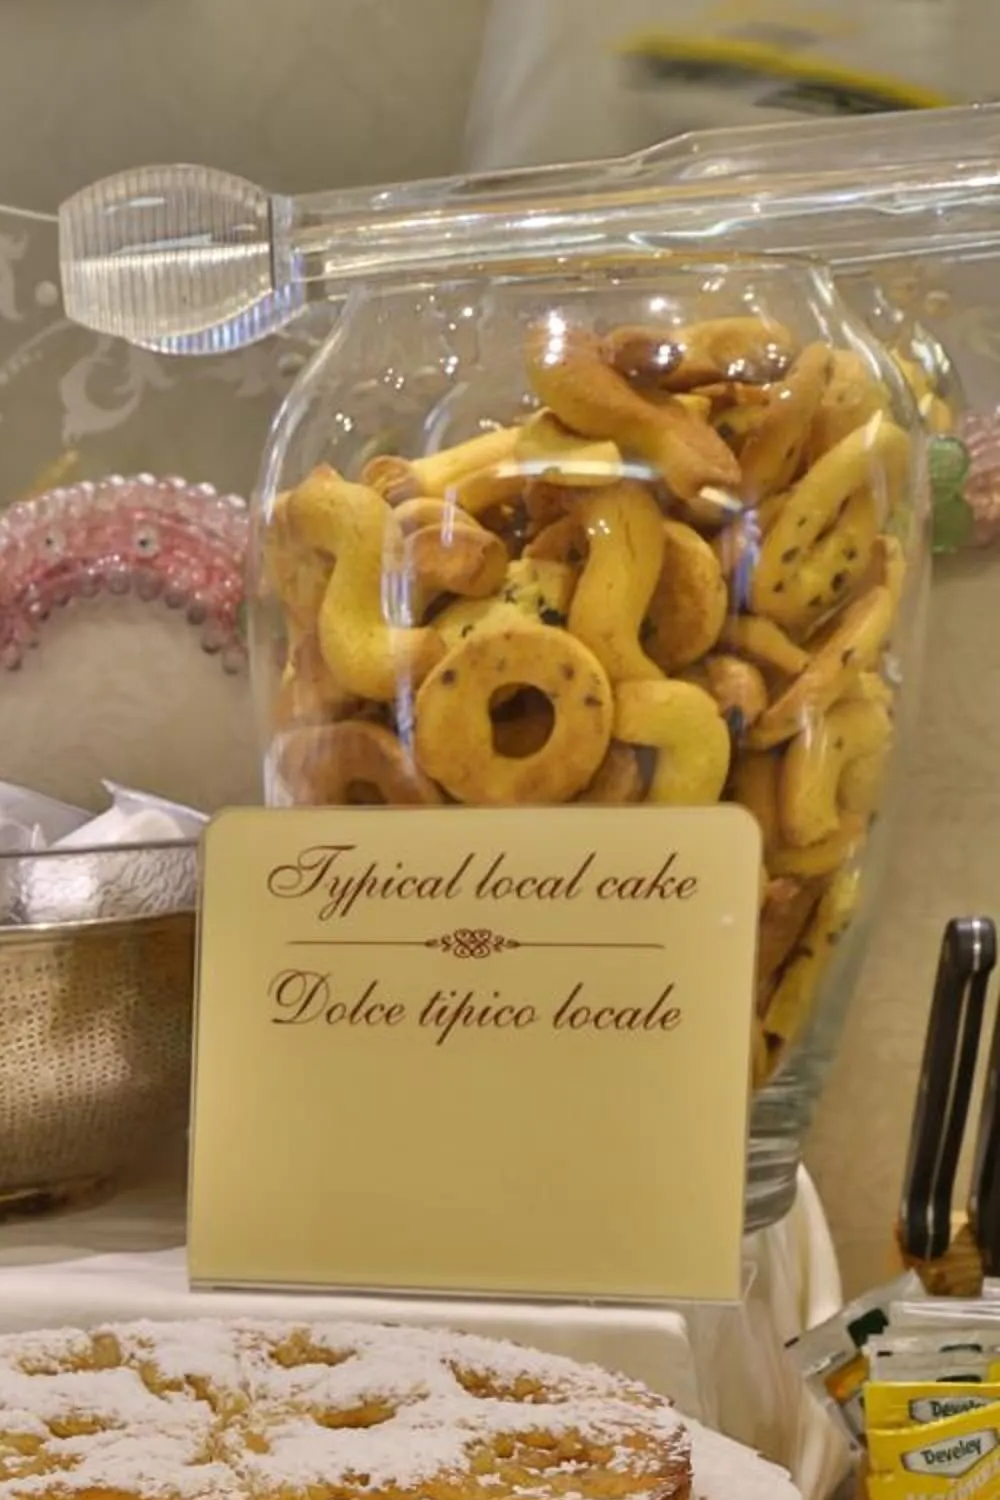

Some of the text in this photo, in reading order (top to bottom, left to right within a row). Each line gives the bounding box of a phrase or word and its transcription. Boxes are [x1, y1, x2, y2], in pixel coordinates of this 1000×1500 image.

[267, 844, 698, 921] Typical local cake
[267, 968, 682, 1046] Dolce tipico locale
[920, 1437, 982, 1466] Develey
